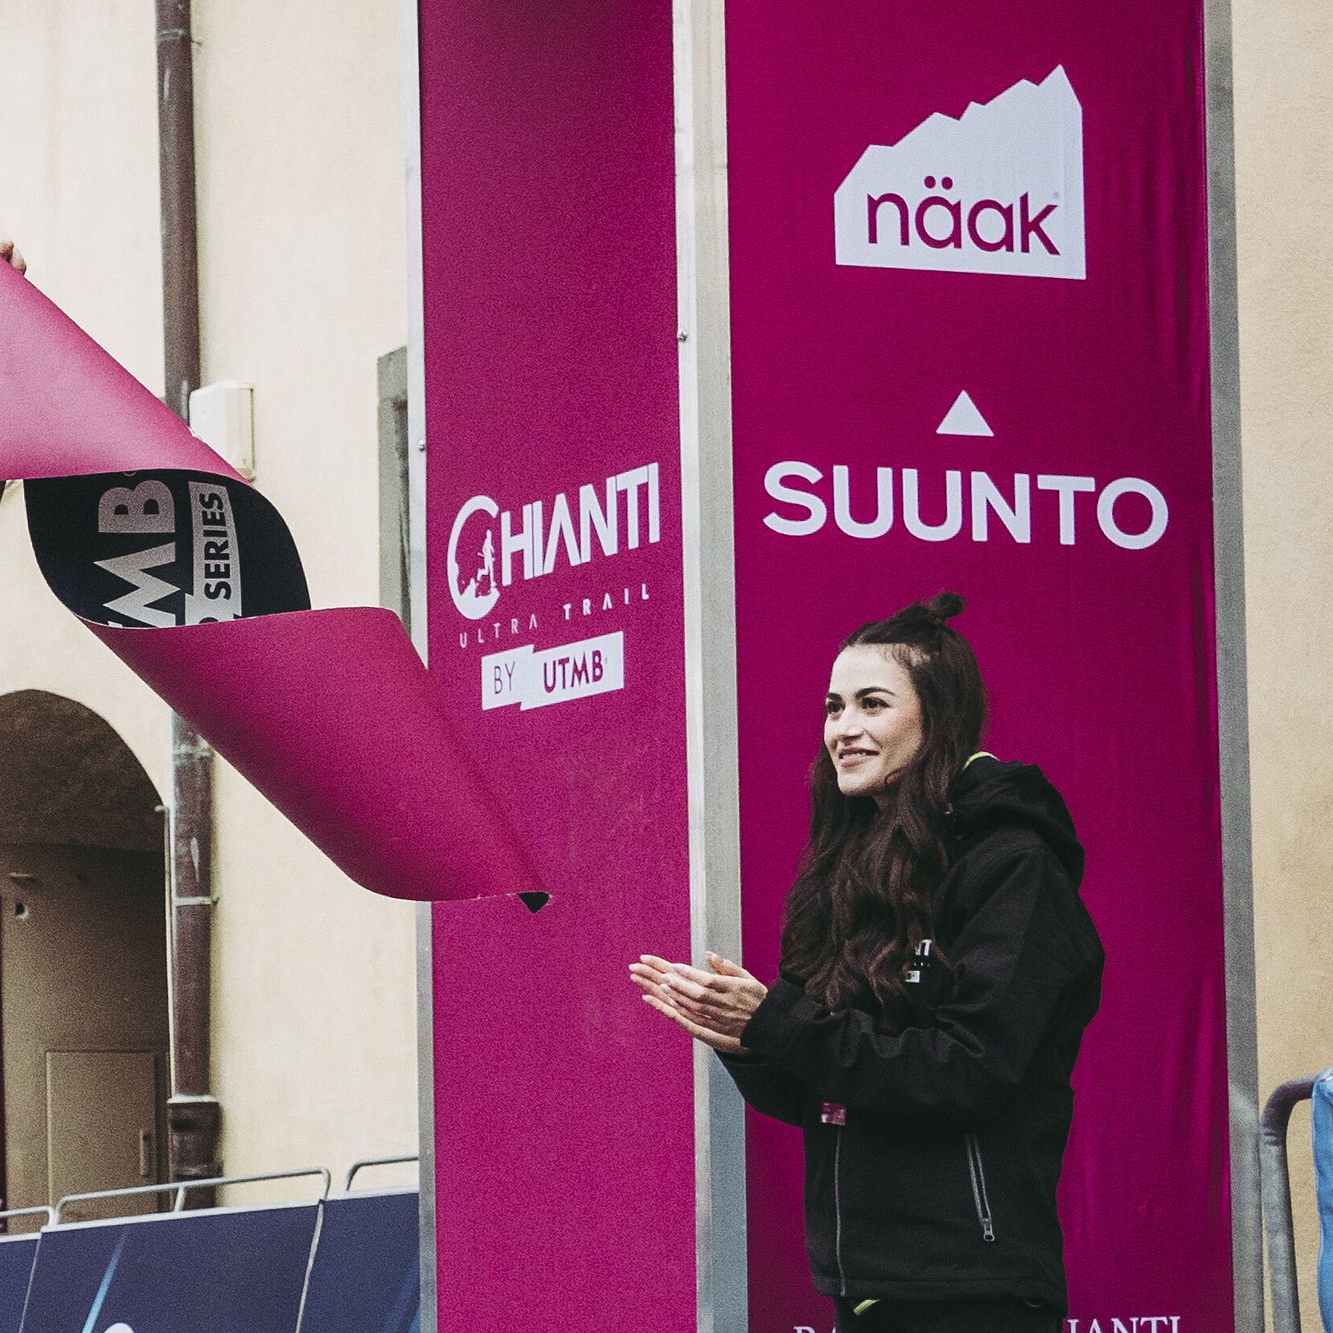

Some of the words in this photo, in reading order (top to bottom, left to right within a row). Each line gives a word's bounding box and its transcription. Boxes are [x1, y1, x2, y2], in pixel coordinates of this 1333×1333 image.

[867, 176, 1060, 256] näak
[203, 489, 233, 602] SERIES
[446, 462, 660, 621] CHIANTI
[763, 460, 1169, 550] SUUNTO
[92, 478, 181, 629] MB
[459, 613, 539, 649] ULTRA
[562, 584, 651, 619] TRAIL
[492, 660, 516, 696] BY
[541, 649, 604, 693] UTMB
